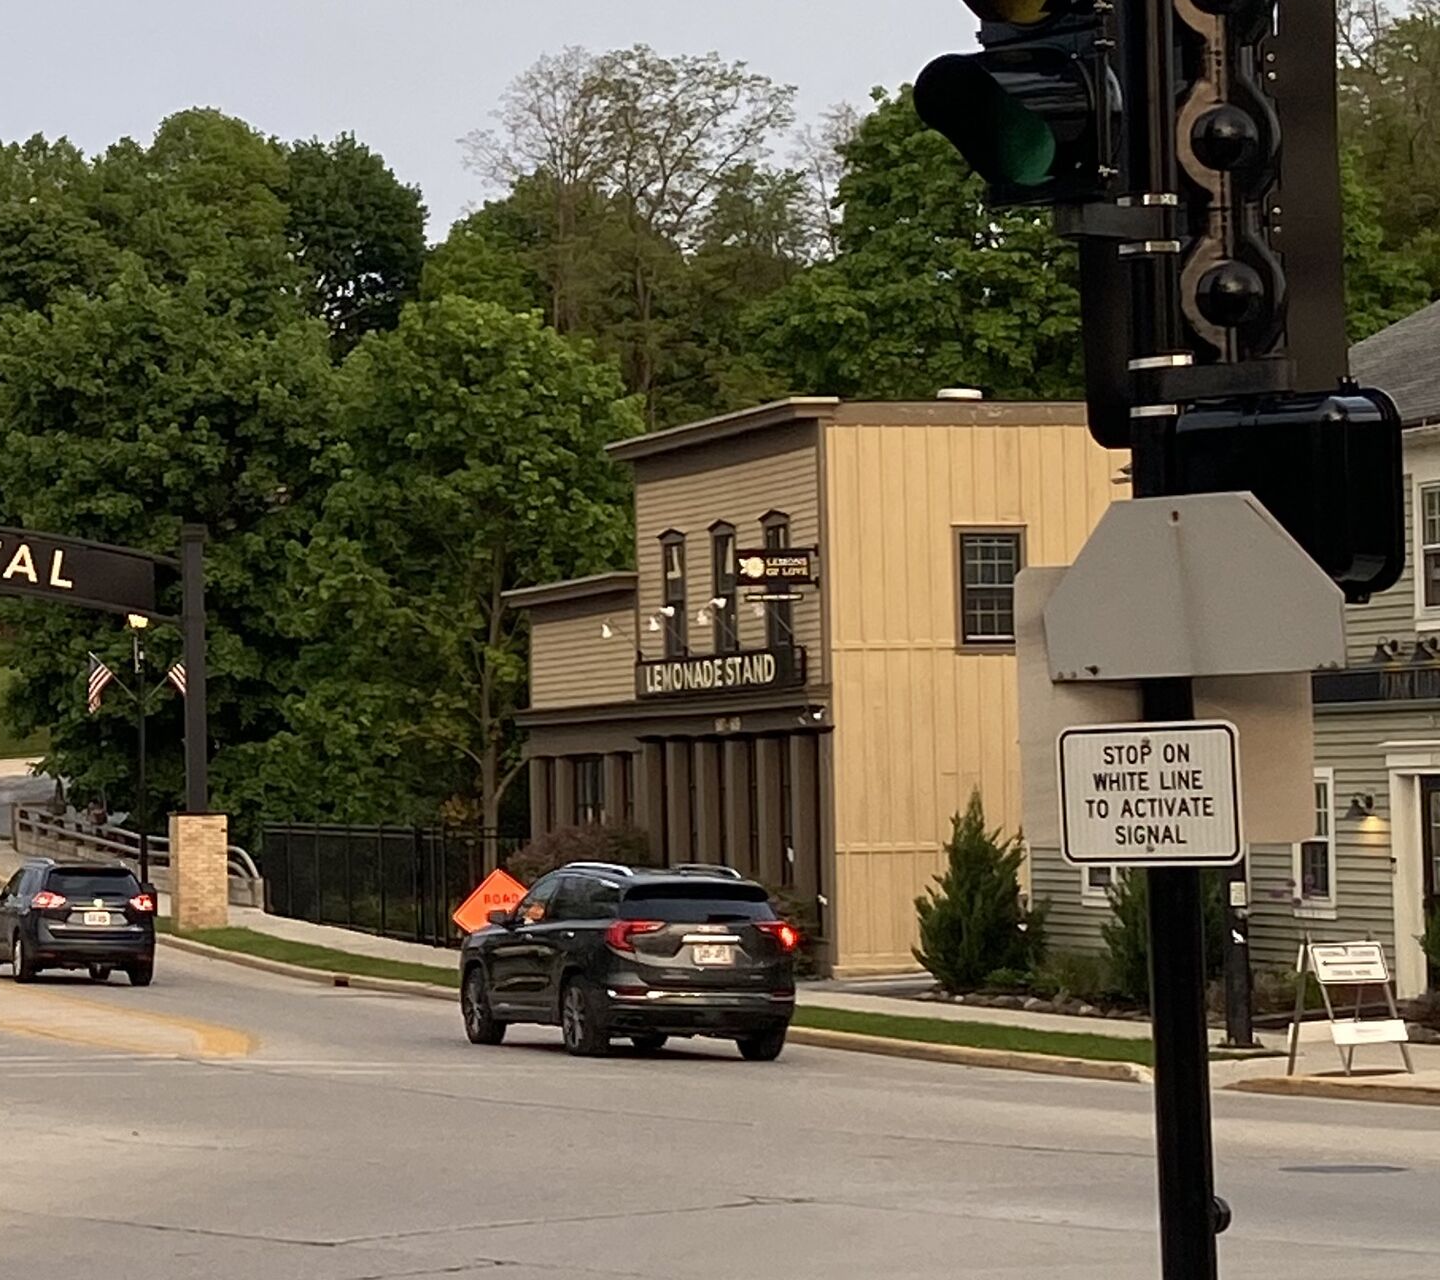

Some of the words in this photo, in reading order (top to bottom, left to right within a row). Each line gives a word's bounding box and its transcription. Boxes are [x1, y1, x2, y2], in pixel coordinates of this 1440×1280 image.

[646, 659, 723, 692] LEMONADE
[725, 654, 775, 686] STAND
[1102, 744, 1152, 765] STOP
[1162, 743, 1190, 763] ON
[1092, 771, 1150, 792] WHITE
[1160, 770, 1203, 790] LINE
[1085, 799, 1109, 819] TO
[1120, 797, 1215, 818] ACTIVATE
[1115, 824, 1187, 845] SIGNAL
[483, 893, 519, 905] ROAD
